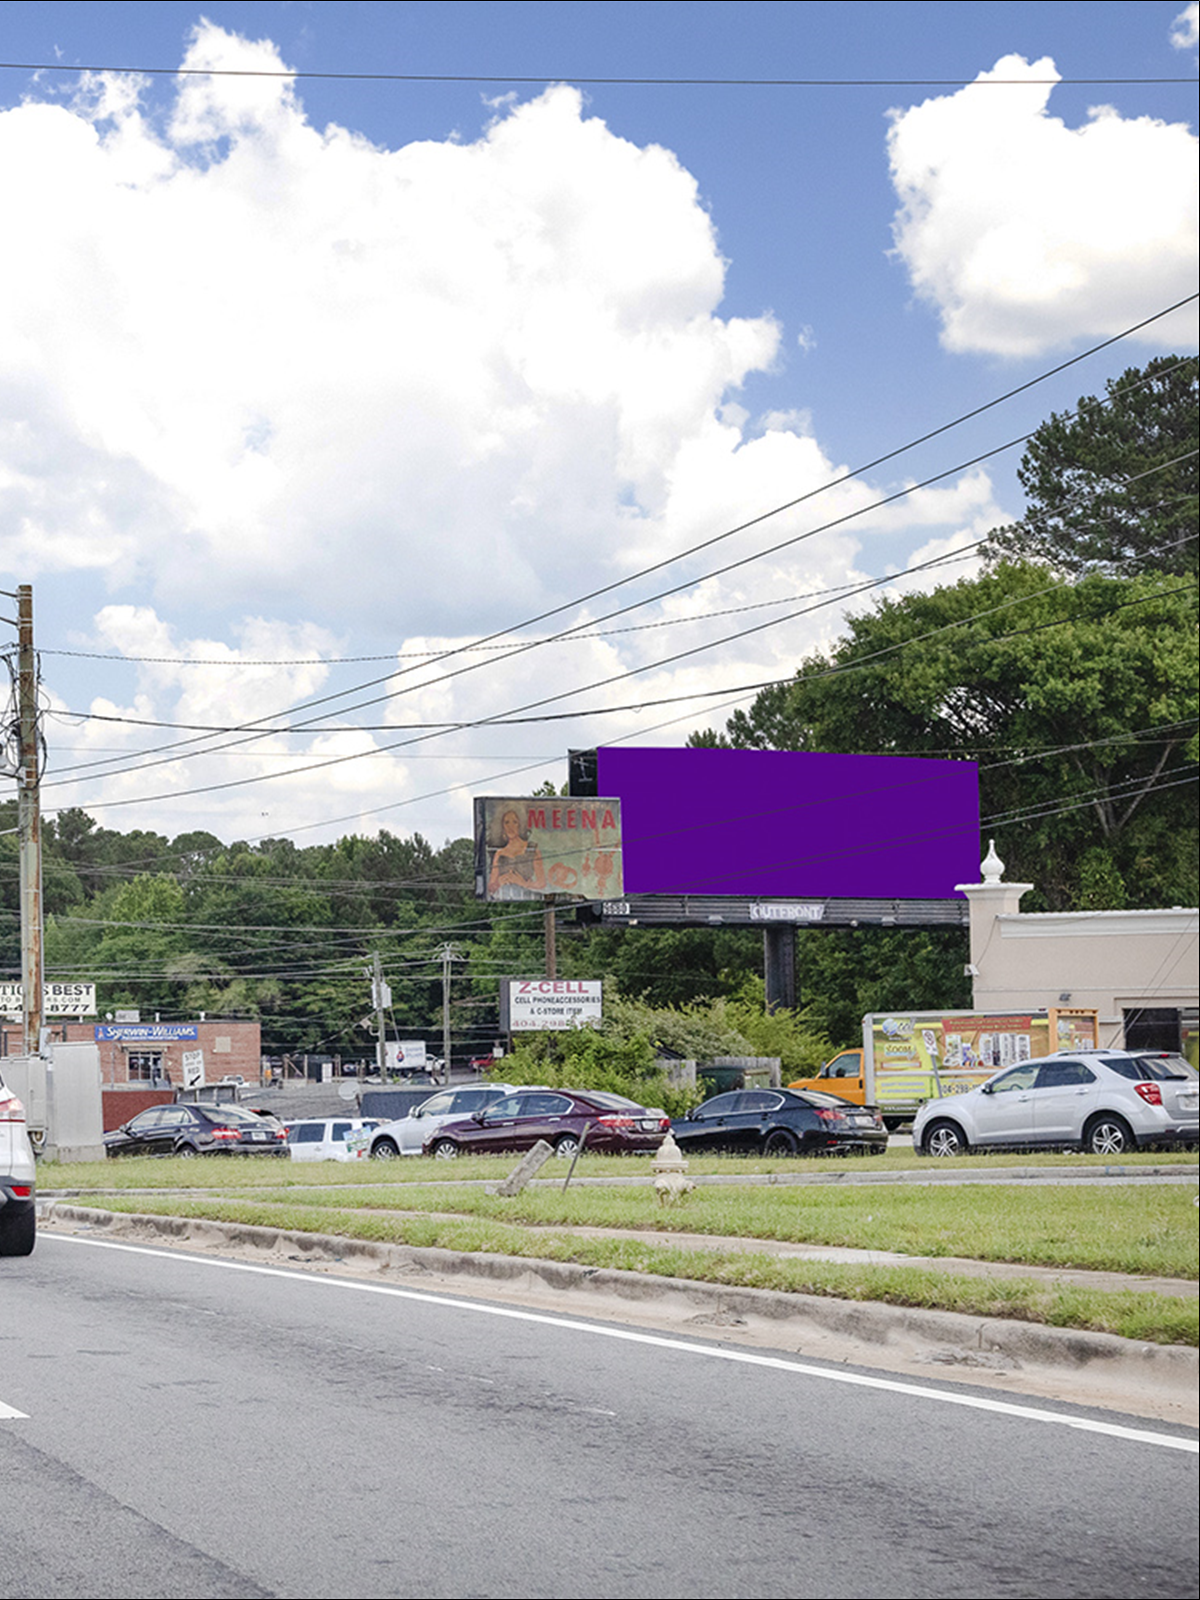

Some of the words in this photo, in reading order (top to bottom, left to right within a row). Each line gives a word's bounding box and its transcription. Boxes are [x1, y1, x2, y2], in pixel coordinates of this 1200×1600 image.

[527, 809, 616, 829] MEENA
[751, 904, 821, 920] OUTFRONT
[52, 984, 93, 996] BEST
[519, 981, 589, 994] Z-CELL
[184, 1052, 201, 1062] STOP
[187, 1066, 200, 1075] RED
